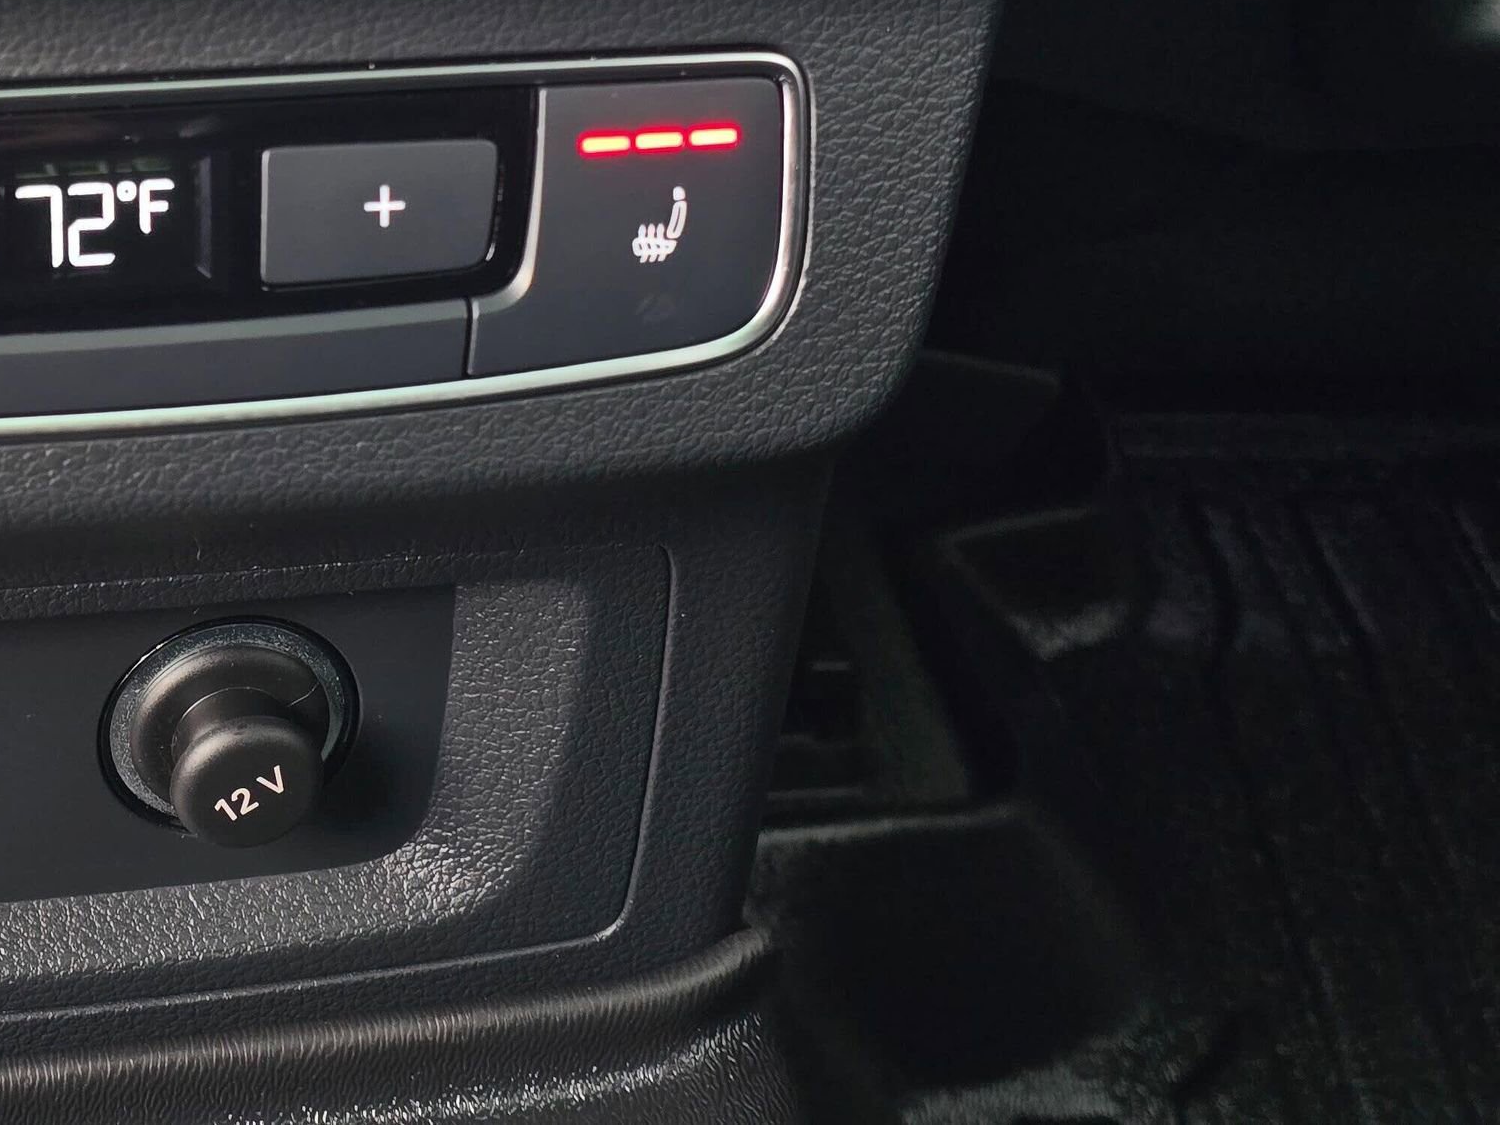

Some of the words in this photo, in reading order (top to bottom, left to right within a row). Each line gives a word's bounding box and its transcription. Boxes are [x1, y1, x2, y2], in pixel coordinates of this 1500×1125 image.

[14, 177, 176, 269] 72°F
[214, 787, 260, 821] 12
[255, 764, 285, 794] V
